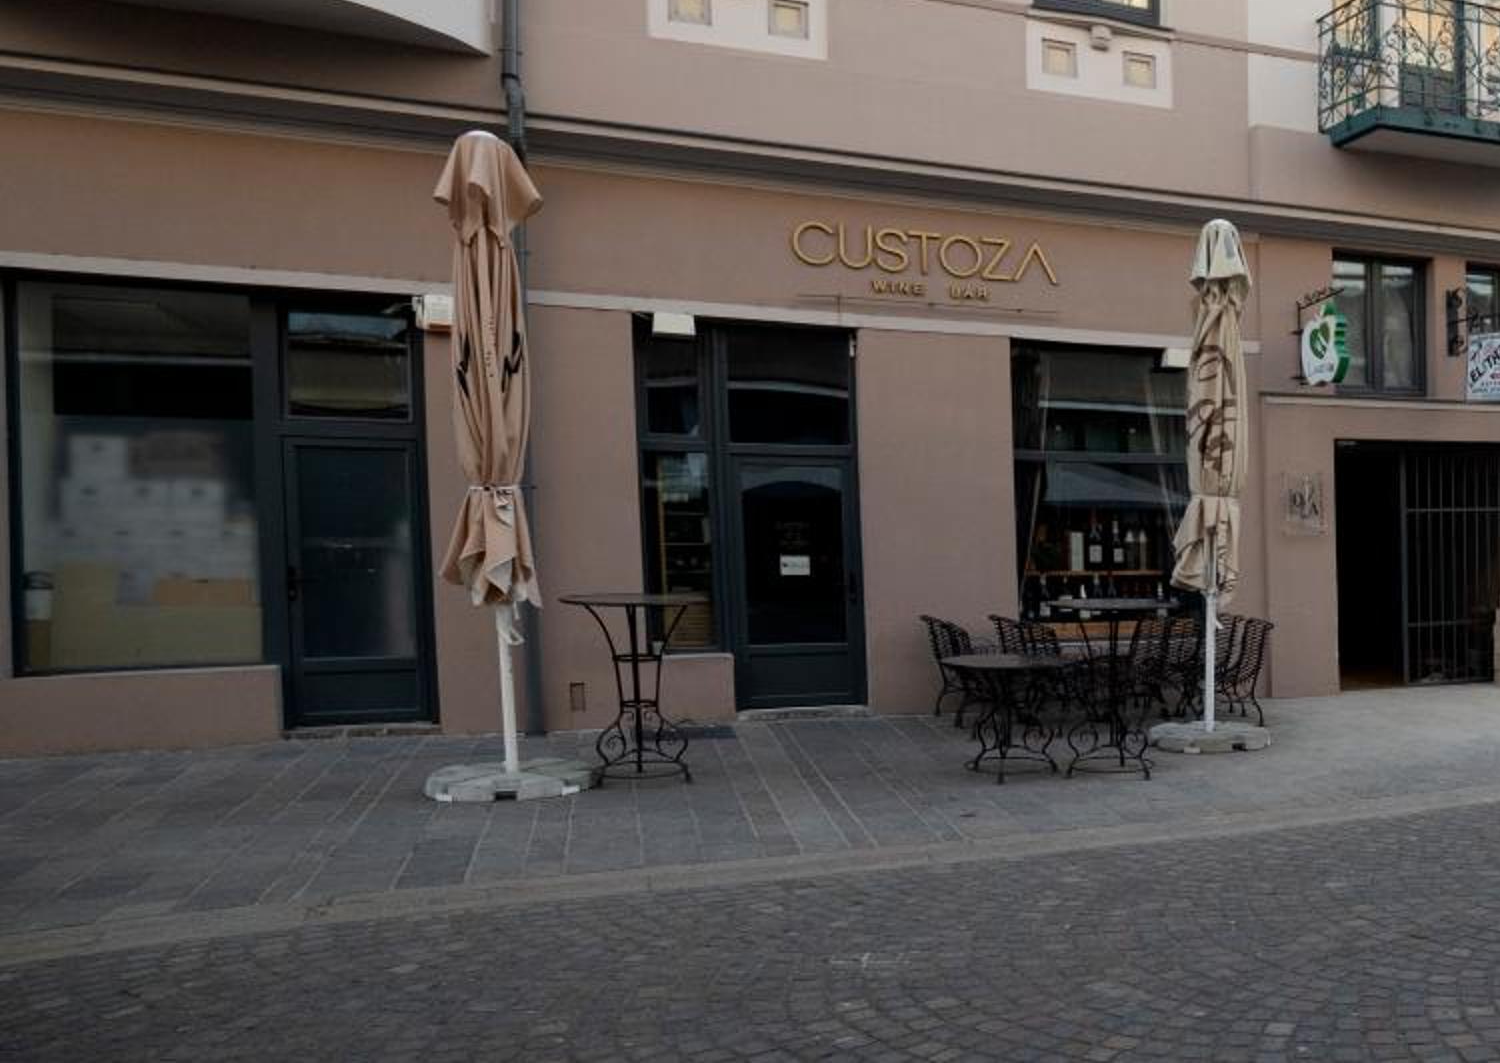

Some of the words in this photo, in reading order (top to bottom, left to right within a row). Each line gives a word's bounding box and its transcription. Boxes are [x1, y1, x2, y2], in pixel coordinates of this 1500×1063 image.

[791, 220, 1058, 285] CUSTOZA
[872, 280, 925, 297] WINE
[949, 282, 991, 300] BAR
